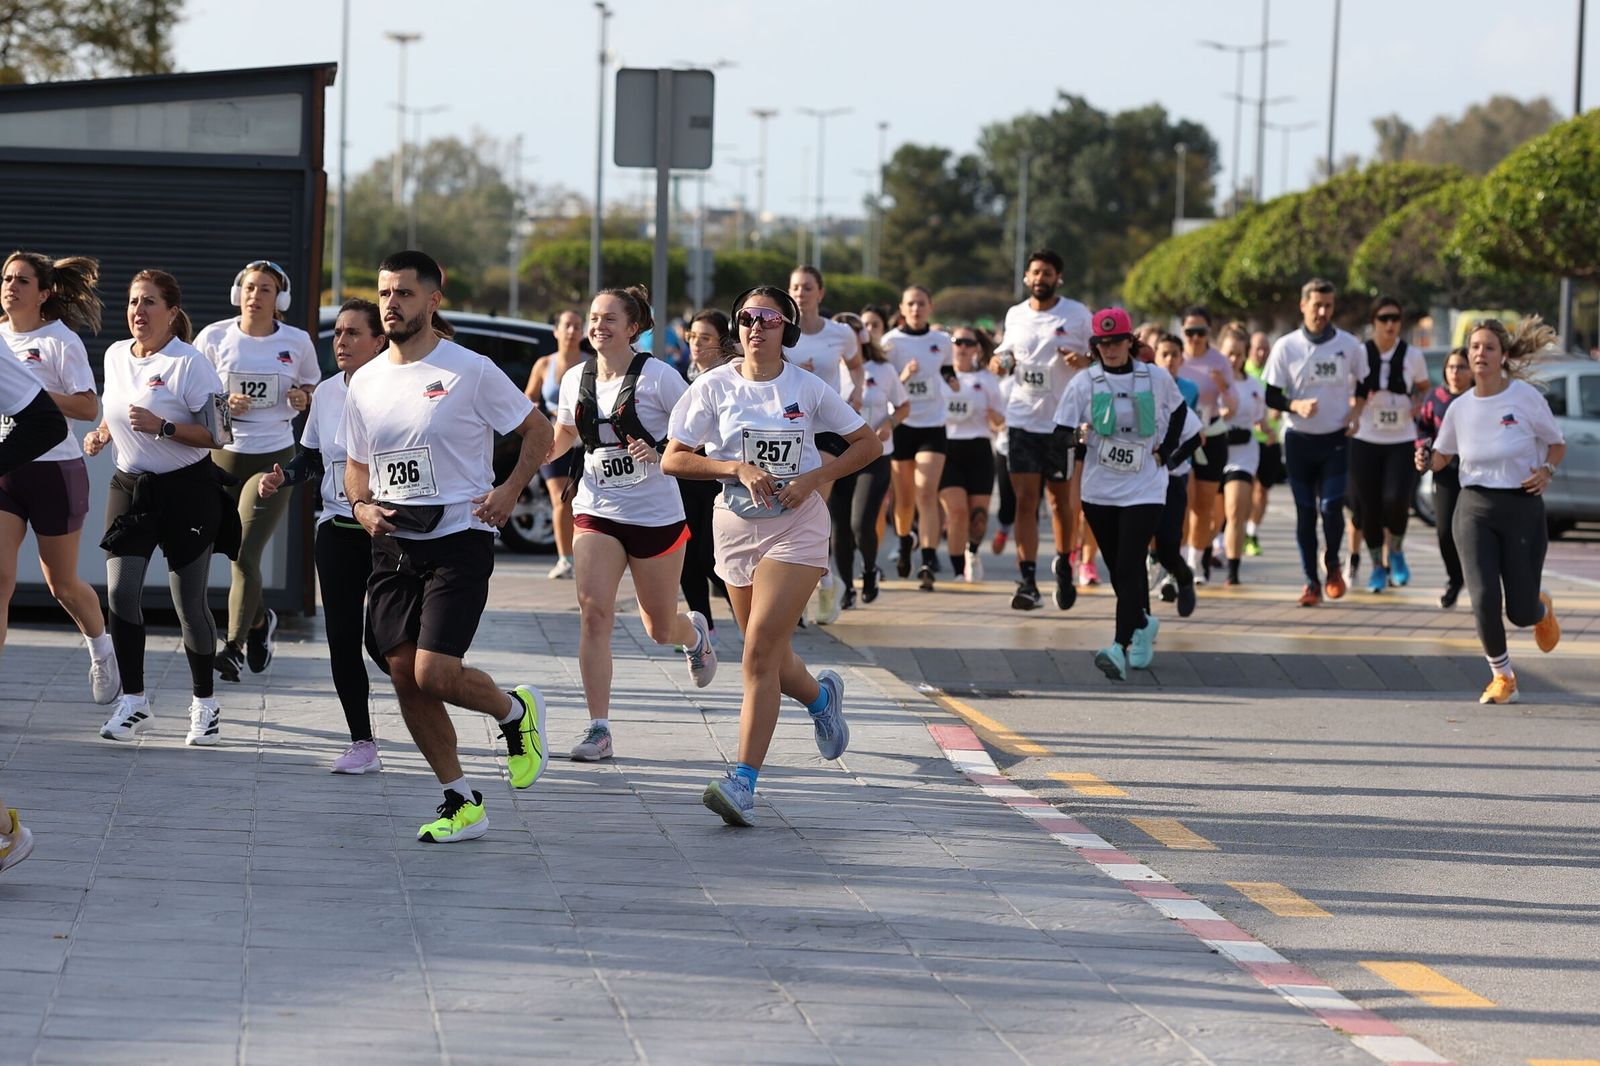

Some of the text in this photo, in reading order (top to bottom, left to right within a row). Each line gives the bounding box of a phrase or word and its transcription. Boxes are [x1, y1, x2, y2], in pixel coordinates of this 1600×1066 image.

[240, 381, 267, 398] 122
[756, 440, 792, 462] 257
[1108, 446, 1134, 465] 495
[387, 460, 420, 486] 236
[601, 456, 634, 478] 508
